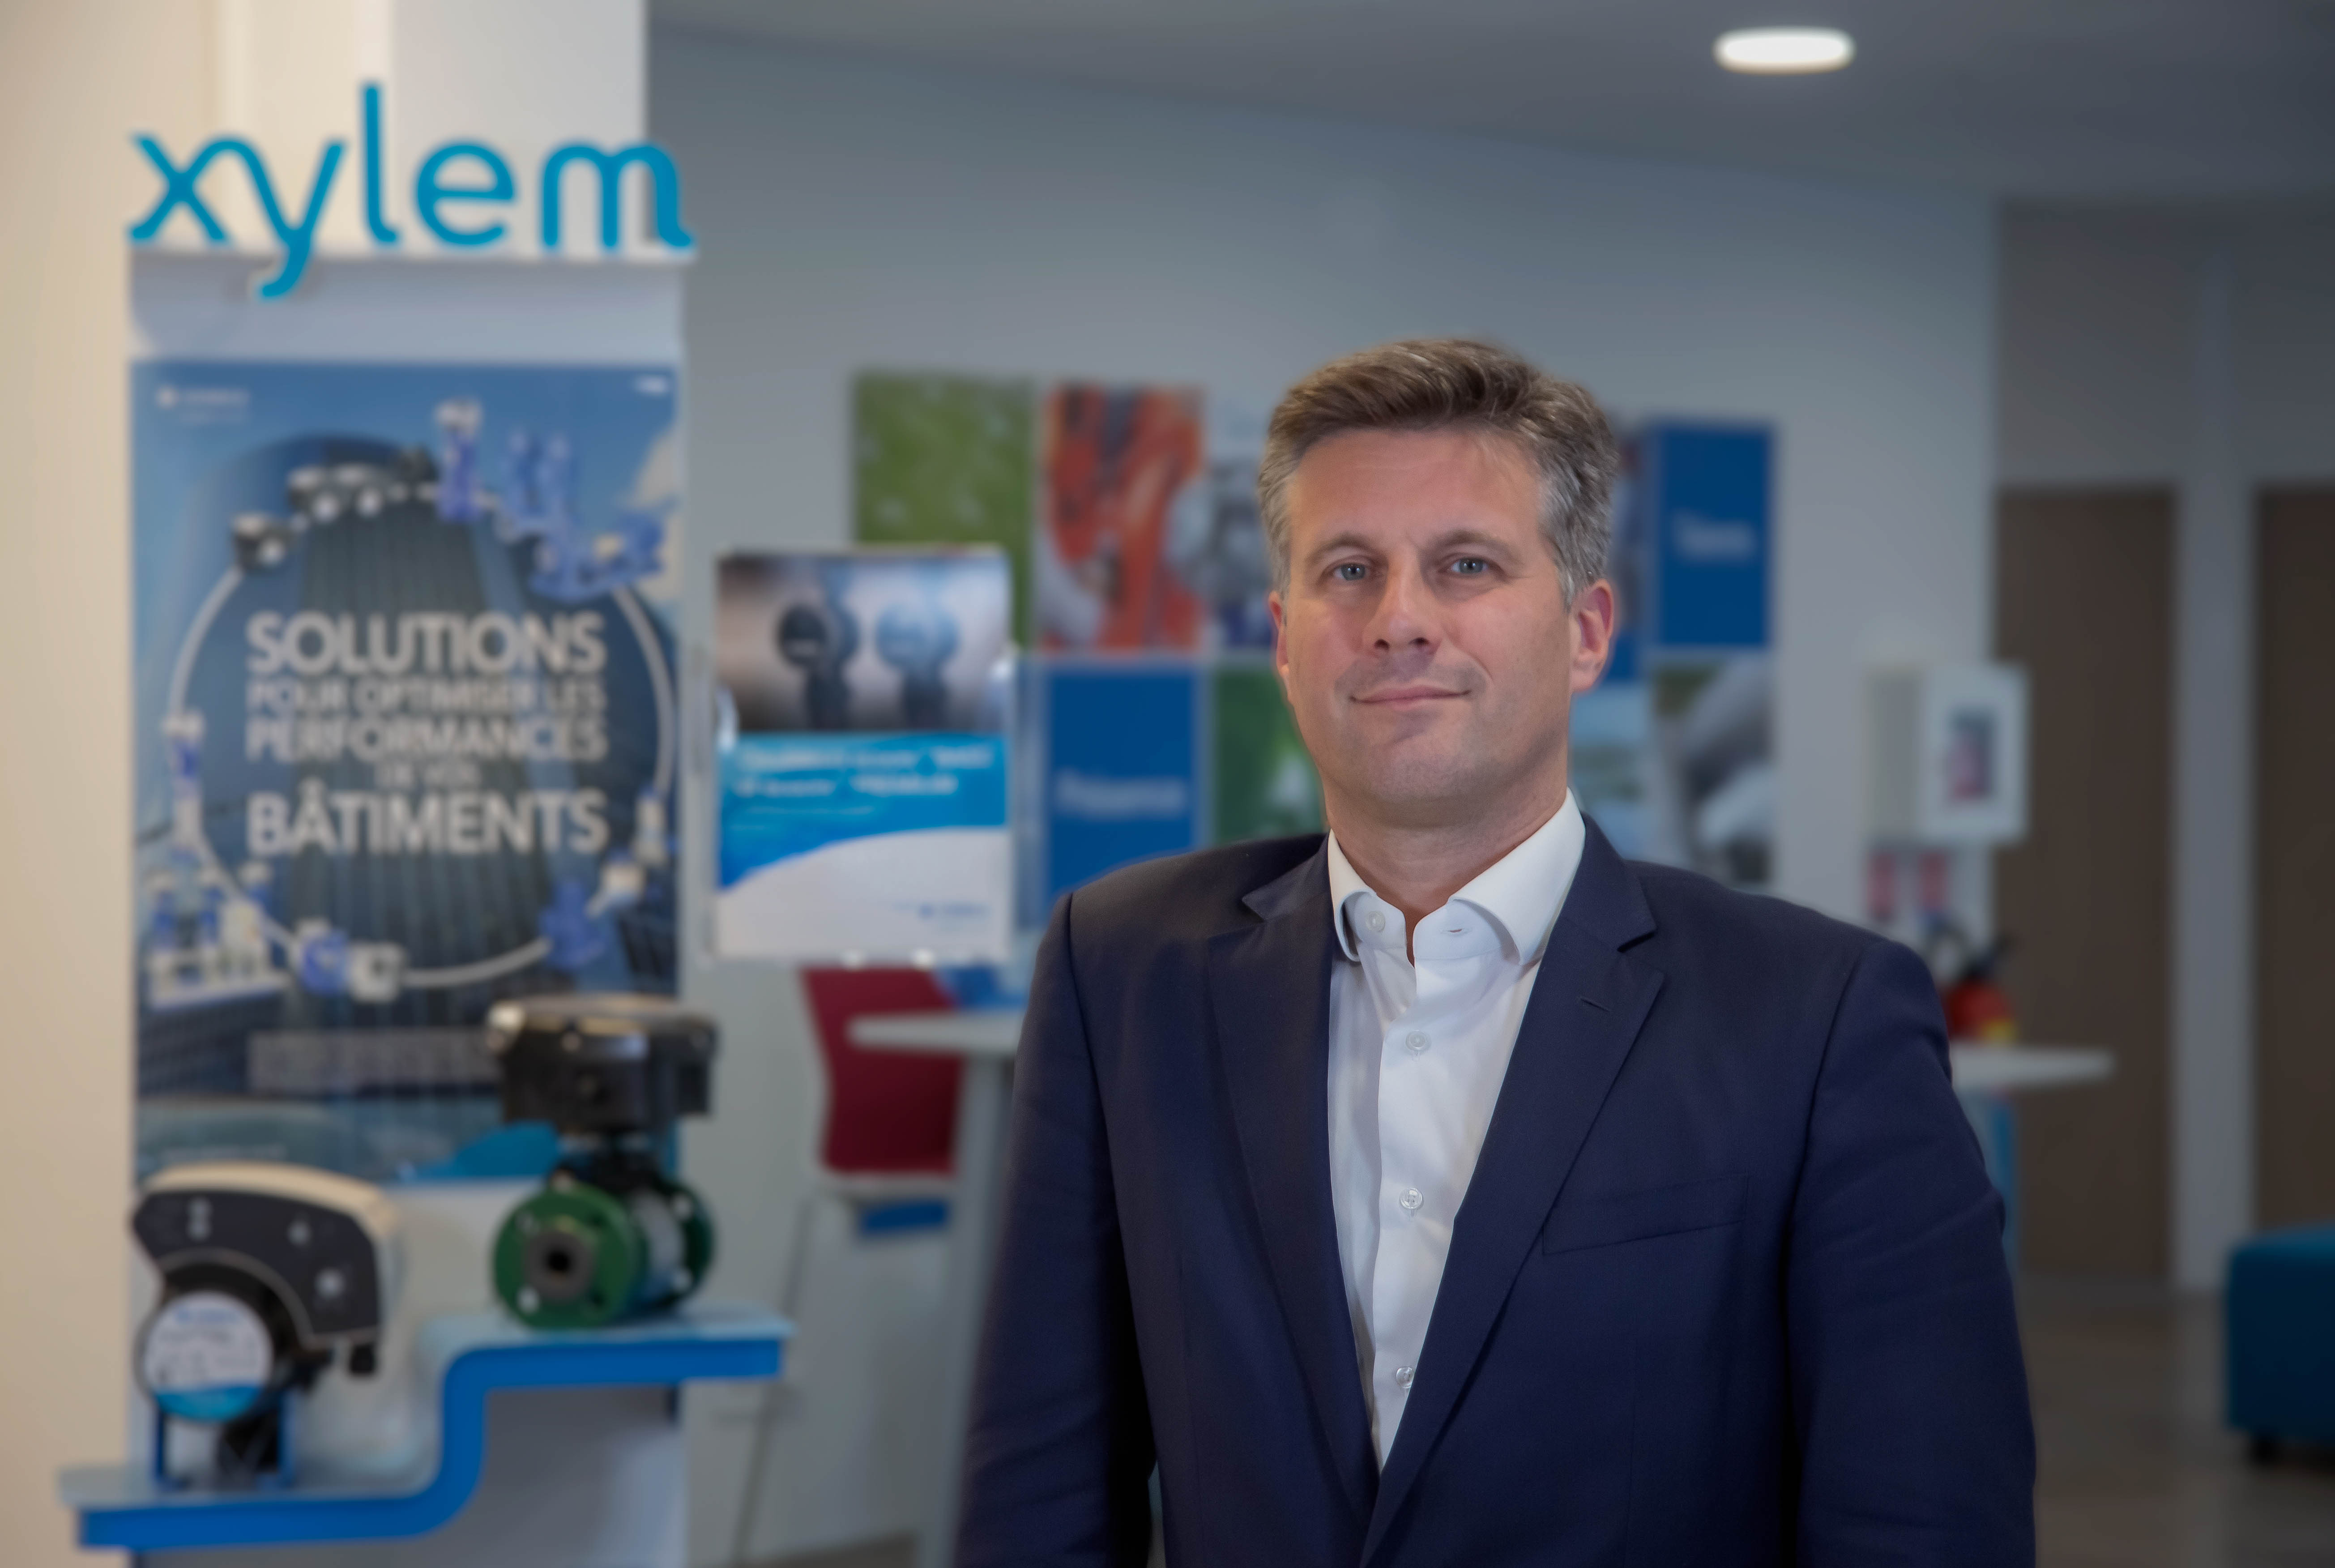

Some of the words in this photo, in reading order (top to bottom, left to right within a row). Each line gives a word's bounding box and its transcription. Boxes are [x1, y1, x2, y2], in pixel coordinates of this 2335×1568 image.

[128, 82, 696, 300] xylem
[244, 611, 608, 674] SOLUTIONS
[246, 678, 348, 713] POUR
[354, 678, 538, 713] OPTIMISER
[546, 678, 607, 713] LES
[246, 715, 609, 763] PERFORMANCES
[246, 777, 610, 855] BÂTIMENTS
